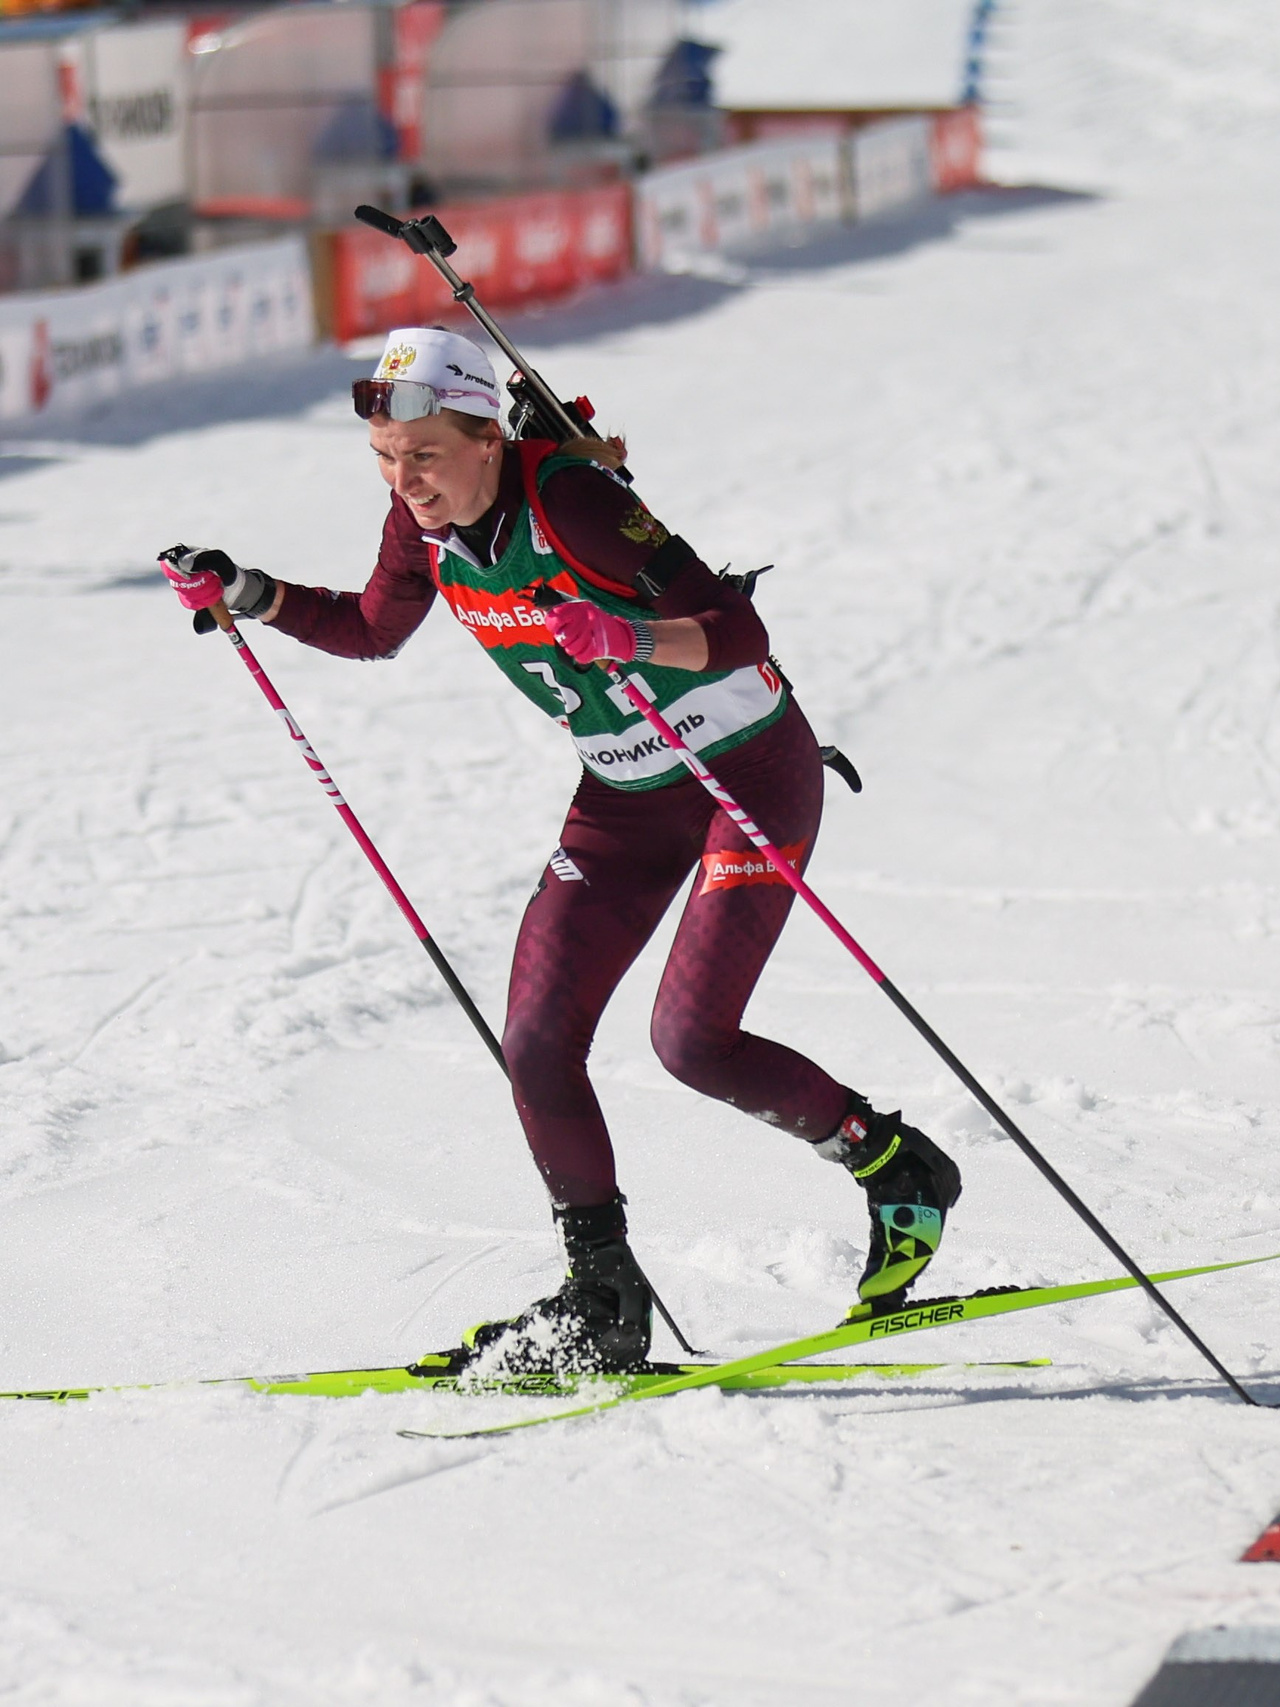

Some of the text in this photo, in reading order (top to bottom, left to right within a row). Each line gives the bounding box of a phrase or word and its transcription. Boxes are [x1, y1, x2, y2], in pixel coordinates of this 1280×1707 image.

[455, 603, 547, 633] Альфа Ба
[712, 859, 796, 881] Альфа Бк
[869, 1304, 964, 1337] FISCHER
[432, 1377, 562, 1391] FICHER
